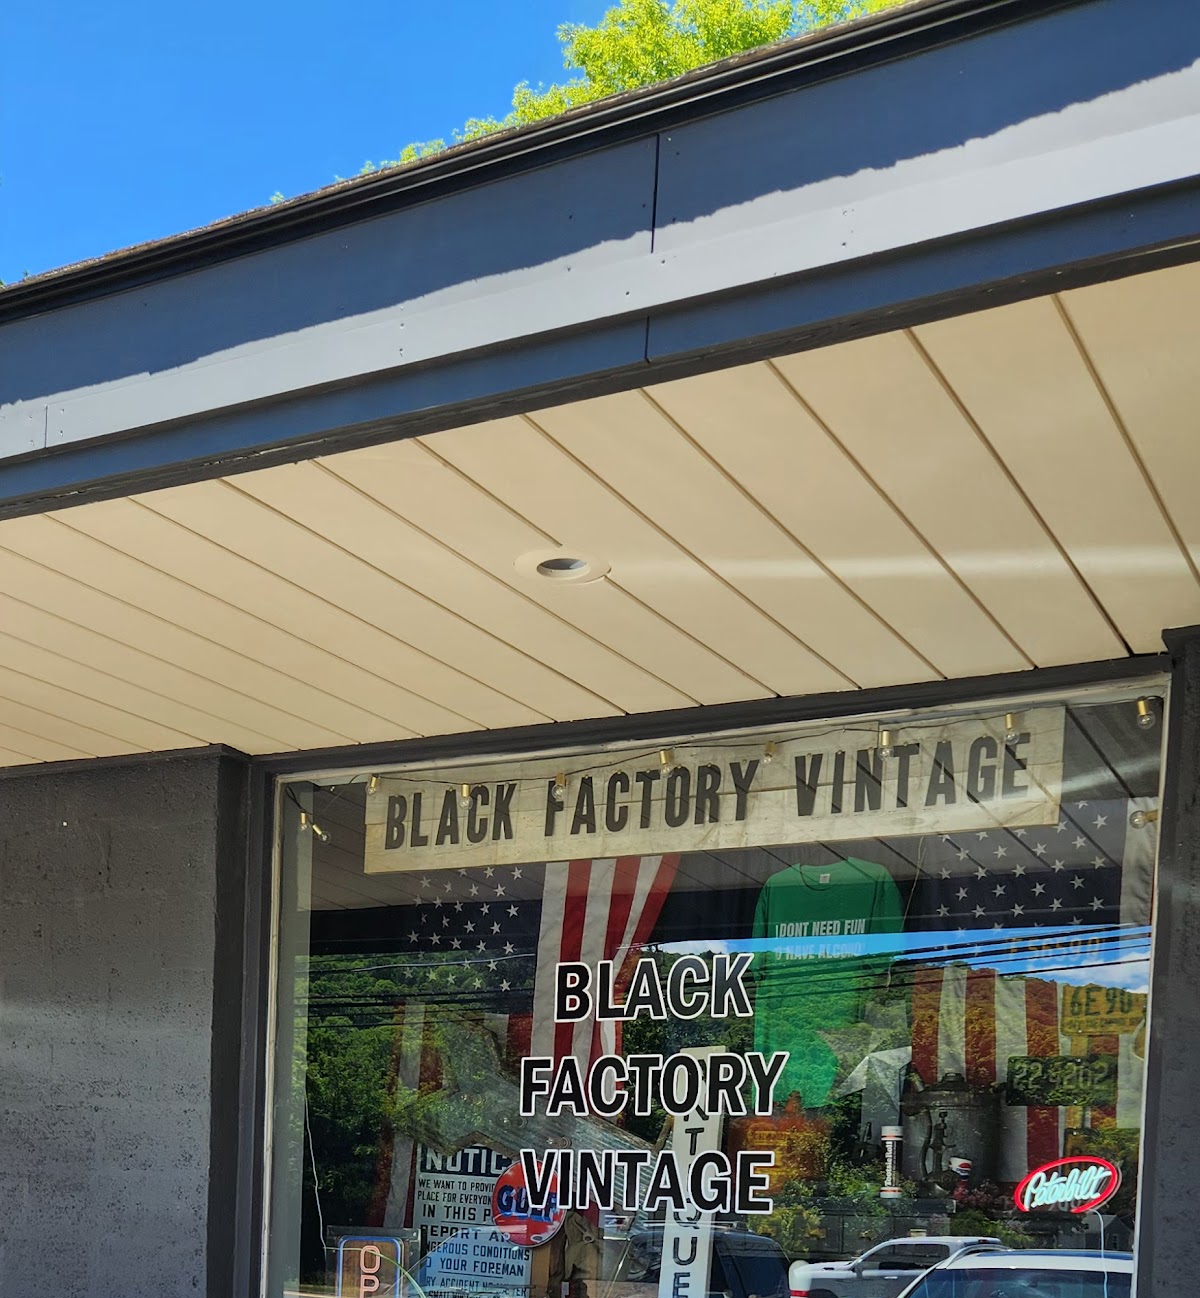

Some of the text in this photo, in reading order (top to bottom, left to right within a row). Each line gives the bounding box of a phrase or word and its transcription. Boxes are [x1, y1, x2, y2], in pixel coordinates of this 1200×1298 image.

[385, 732, 1031, 849] BLACK FACTORY VINTAGE
[780, 922, 809, 938] DONT
[812, 920, 840, 936] NEED
[844, 918, 866, 935] FUN
[554, 953, 754, 1023] BLACK
[520, 1052, 790, 1116] FACTORY
[425, 1148, 508, 1174] NOTIC
[418, 1178, 431, 1188] WE
[433, 1179, 454, 1190] WANT
[457, 1181, 467, 1191] TO
[520, 1149, 775, 1214] VINTAGE
[417, 1190, 492, 1206] PLACE FOR EVERYON
[422, 1204, 435, 1218] IN
[444, 1205, 477, 1221] THIS
[473, 1244, 530, 1261] CONDITIONS
[440, 1257, 467, 1271] YOUR
[473, 1260, 524, 1277] FOREMAN
